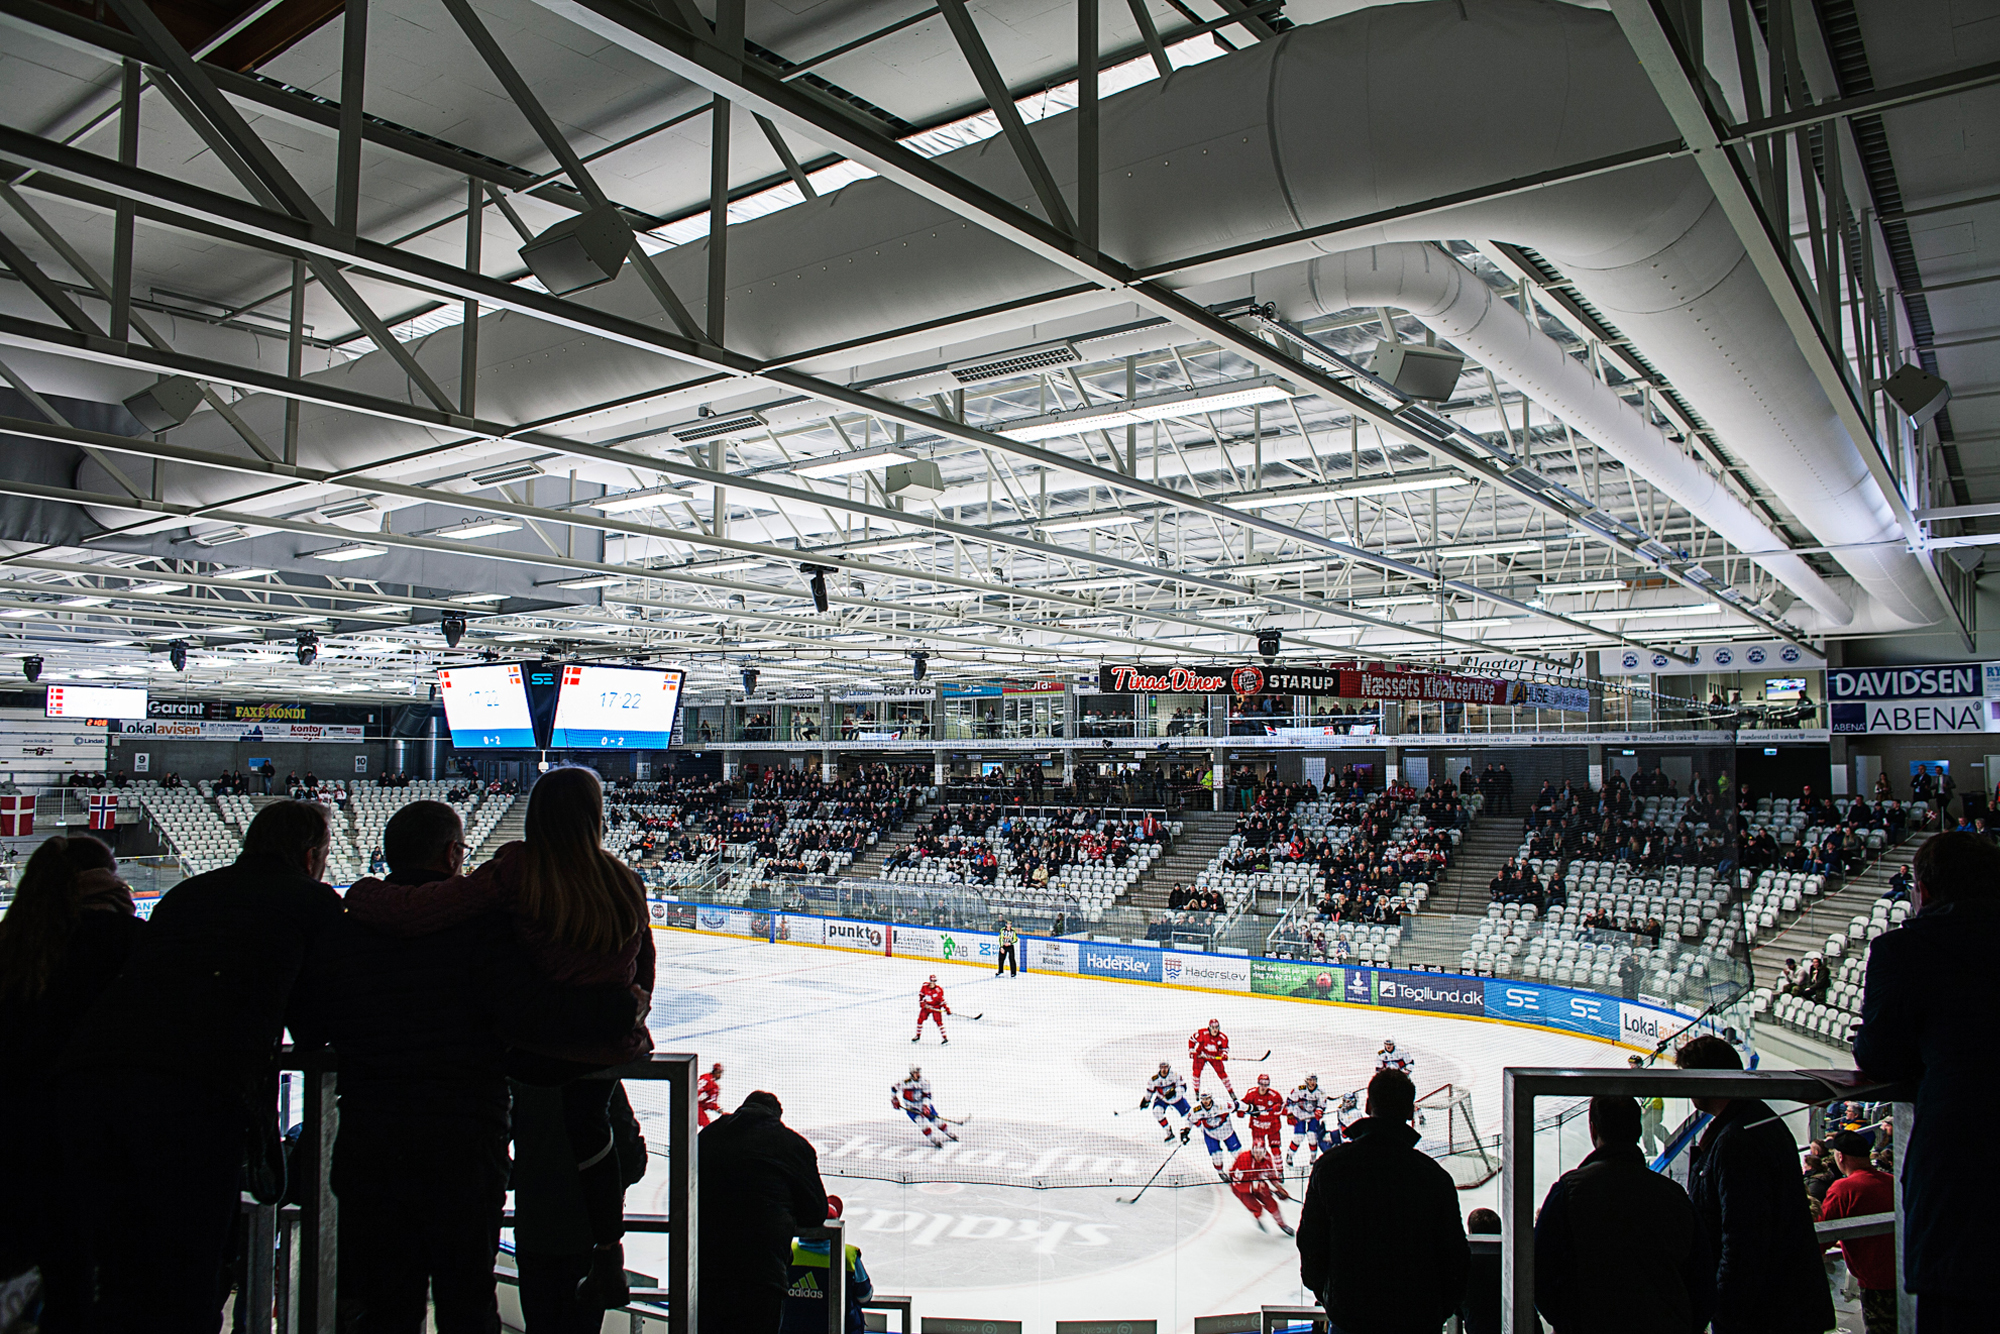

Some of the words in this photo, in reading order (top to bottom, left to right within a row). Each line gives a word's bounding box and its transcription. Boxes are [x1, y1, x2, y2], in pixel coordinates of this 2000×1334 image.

[531, 673, 554, 685] SE
[1111, 665, 1171, 691] Tinas
[1169, 667, 1227, 691] Diner
[1269, 674, 1334, 690] STARUP
[1836, 668, 1974, 696] DAVIDSEN
[1360, 673, 1420, 697] Næssets
[1423, 676, 1496, 701] Kloakservice
[147, 700, 205, 715] Garant
[235, 706, 266, 719] FAXE
[268, 707, 306, 719] KONDI
[1870, 706, 1981, 731] ABENA
[119, 721, 200, 735] Lokalavisen
[290, 725, 323, 733] kontor
[1833, 723, 1865, 732] ABENA
[617, 737, 625, 746] 2
[138, 755, 146, 764] 9
[356, 757, 366, 766] 10
[829, 766, 838, 774] 12
[1086, 953, 1151, 974] Haderslev
[1185, 966, 1246, 981] Haderslev
[1397, 984, 1484, 1006] Tegllund.dk
[1506, 988, 1540, 1010] SE
[1570, 997, 1602, 1021] SE
[788, 1288, 824, 1299] adidas
